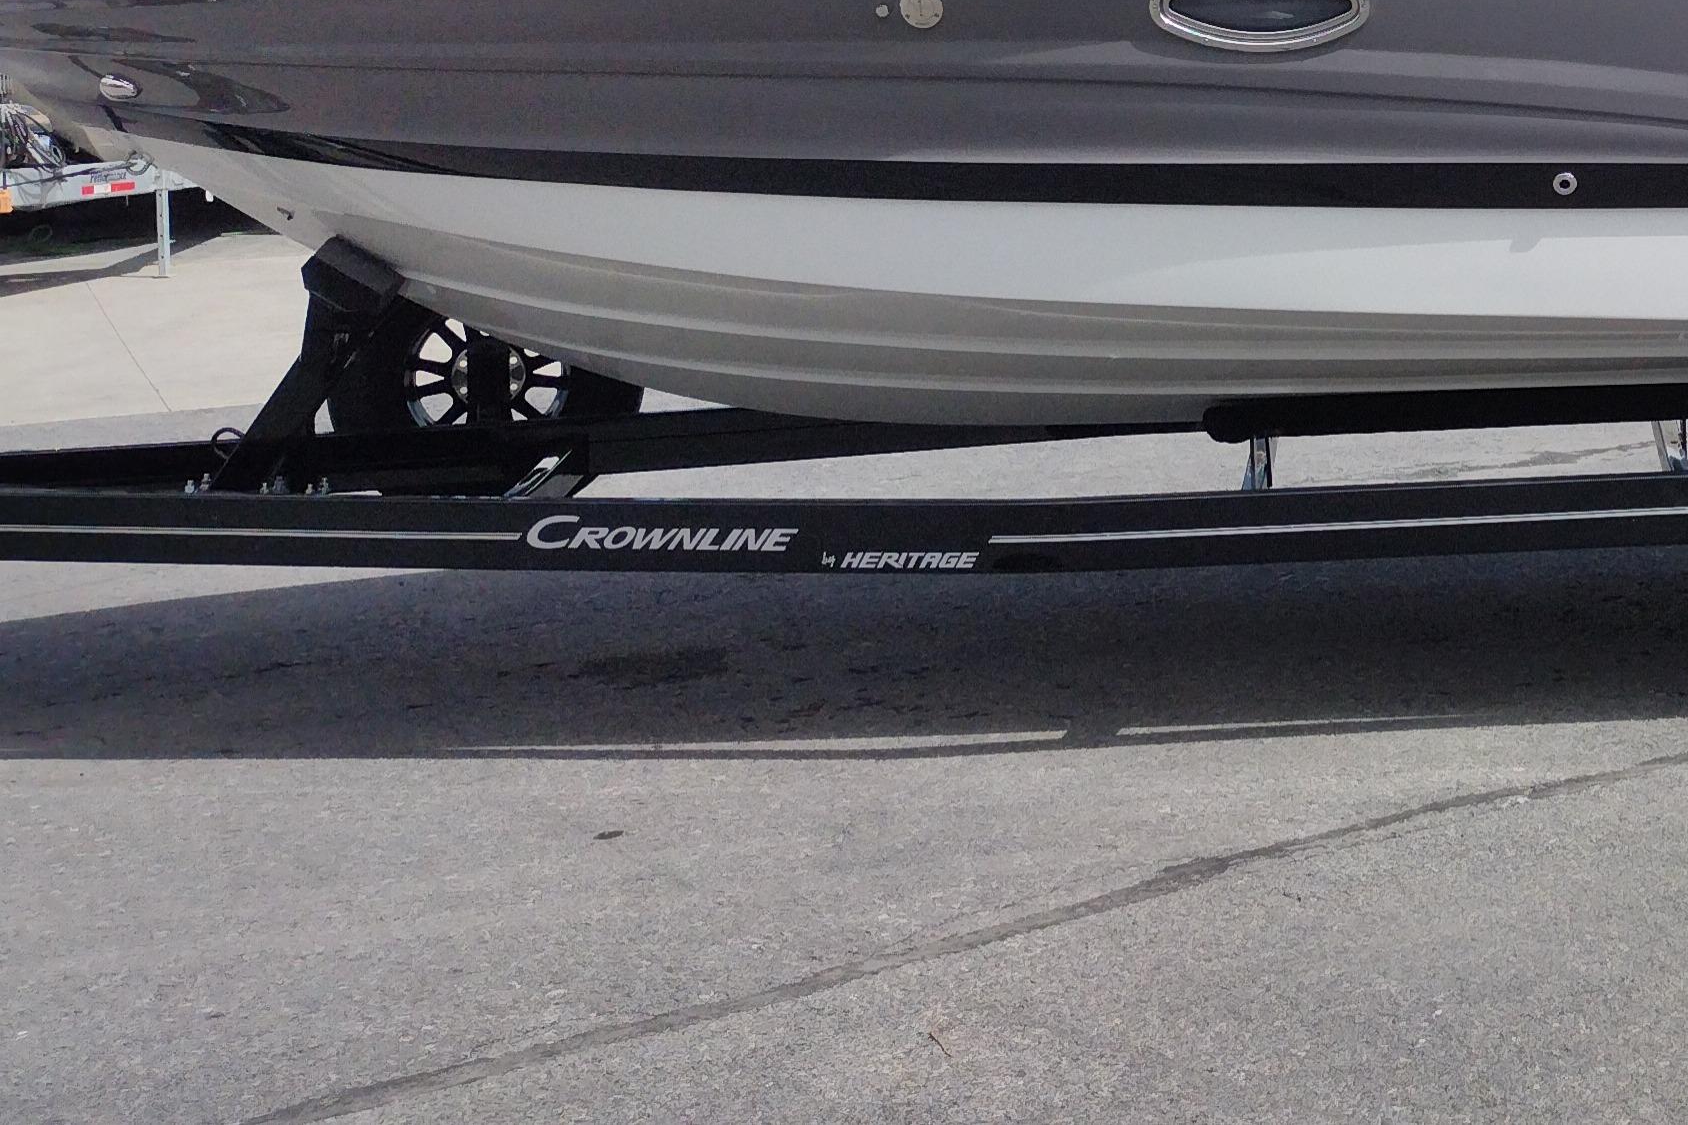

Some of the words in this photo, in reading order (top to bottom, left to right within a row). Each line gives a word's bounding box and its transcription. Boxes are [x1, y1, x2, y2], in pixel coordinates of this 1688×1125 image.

[526, 515, 799, 552] CROWNLINE
[822, 551, 836, 568] by
[840, 551, 980, 569] HERITAGE
